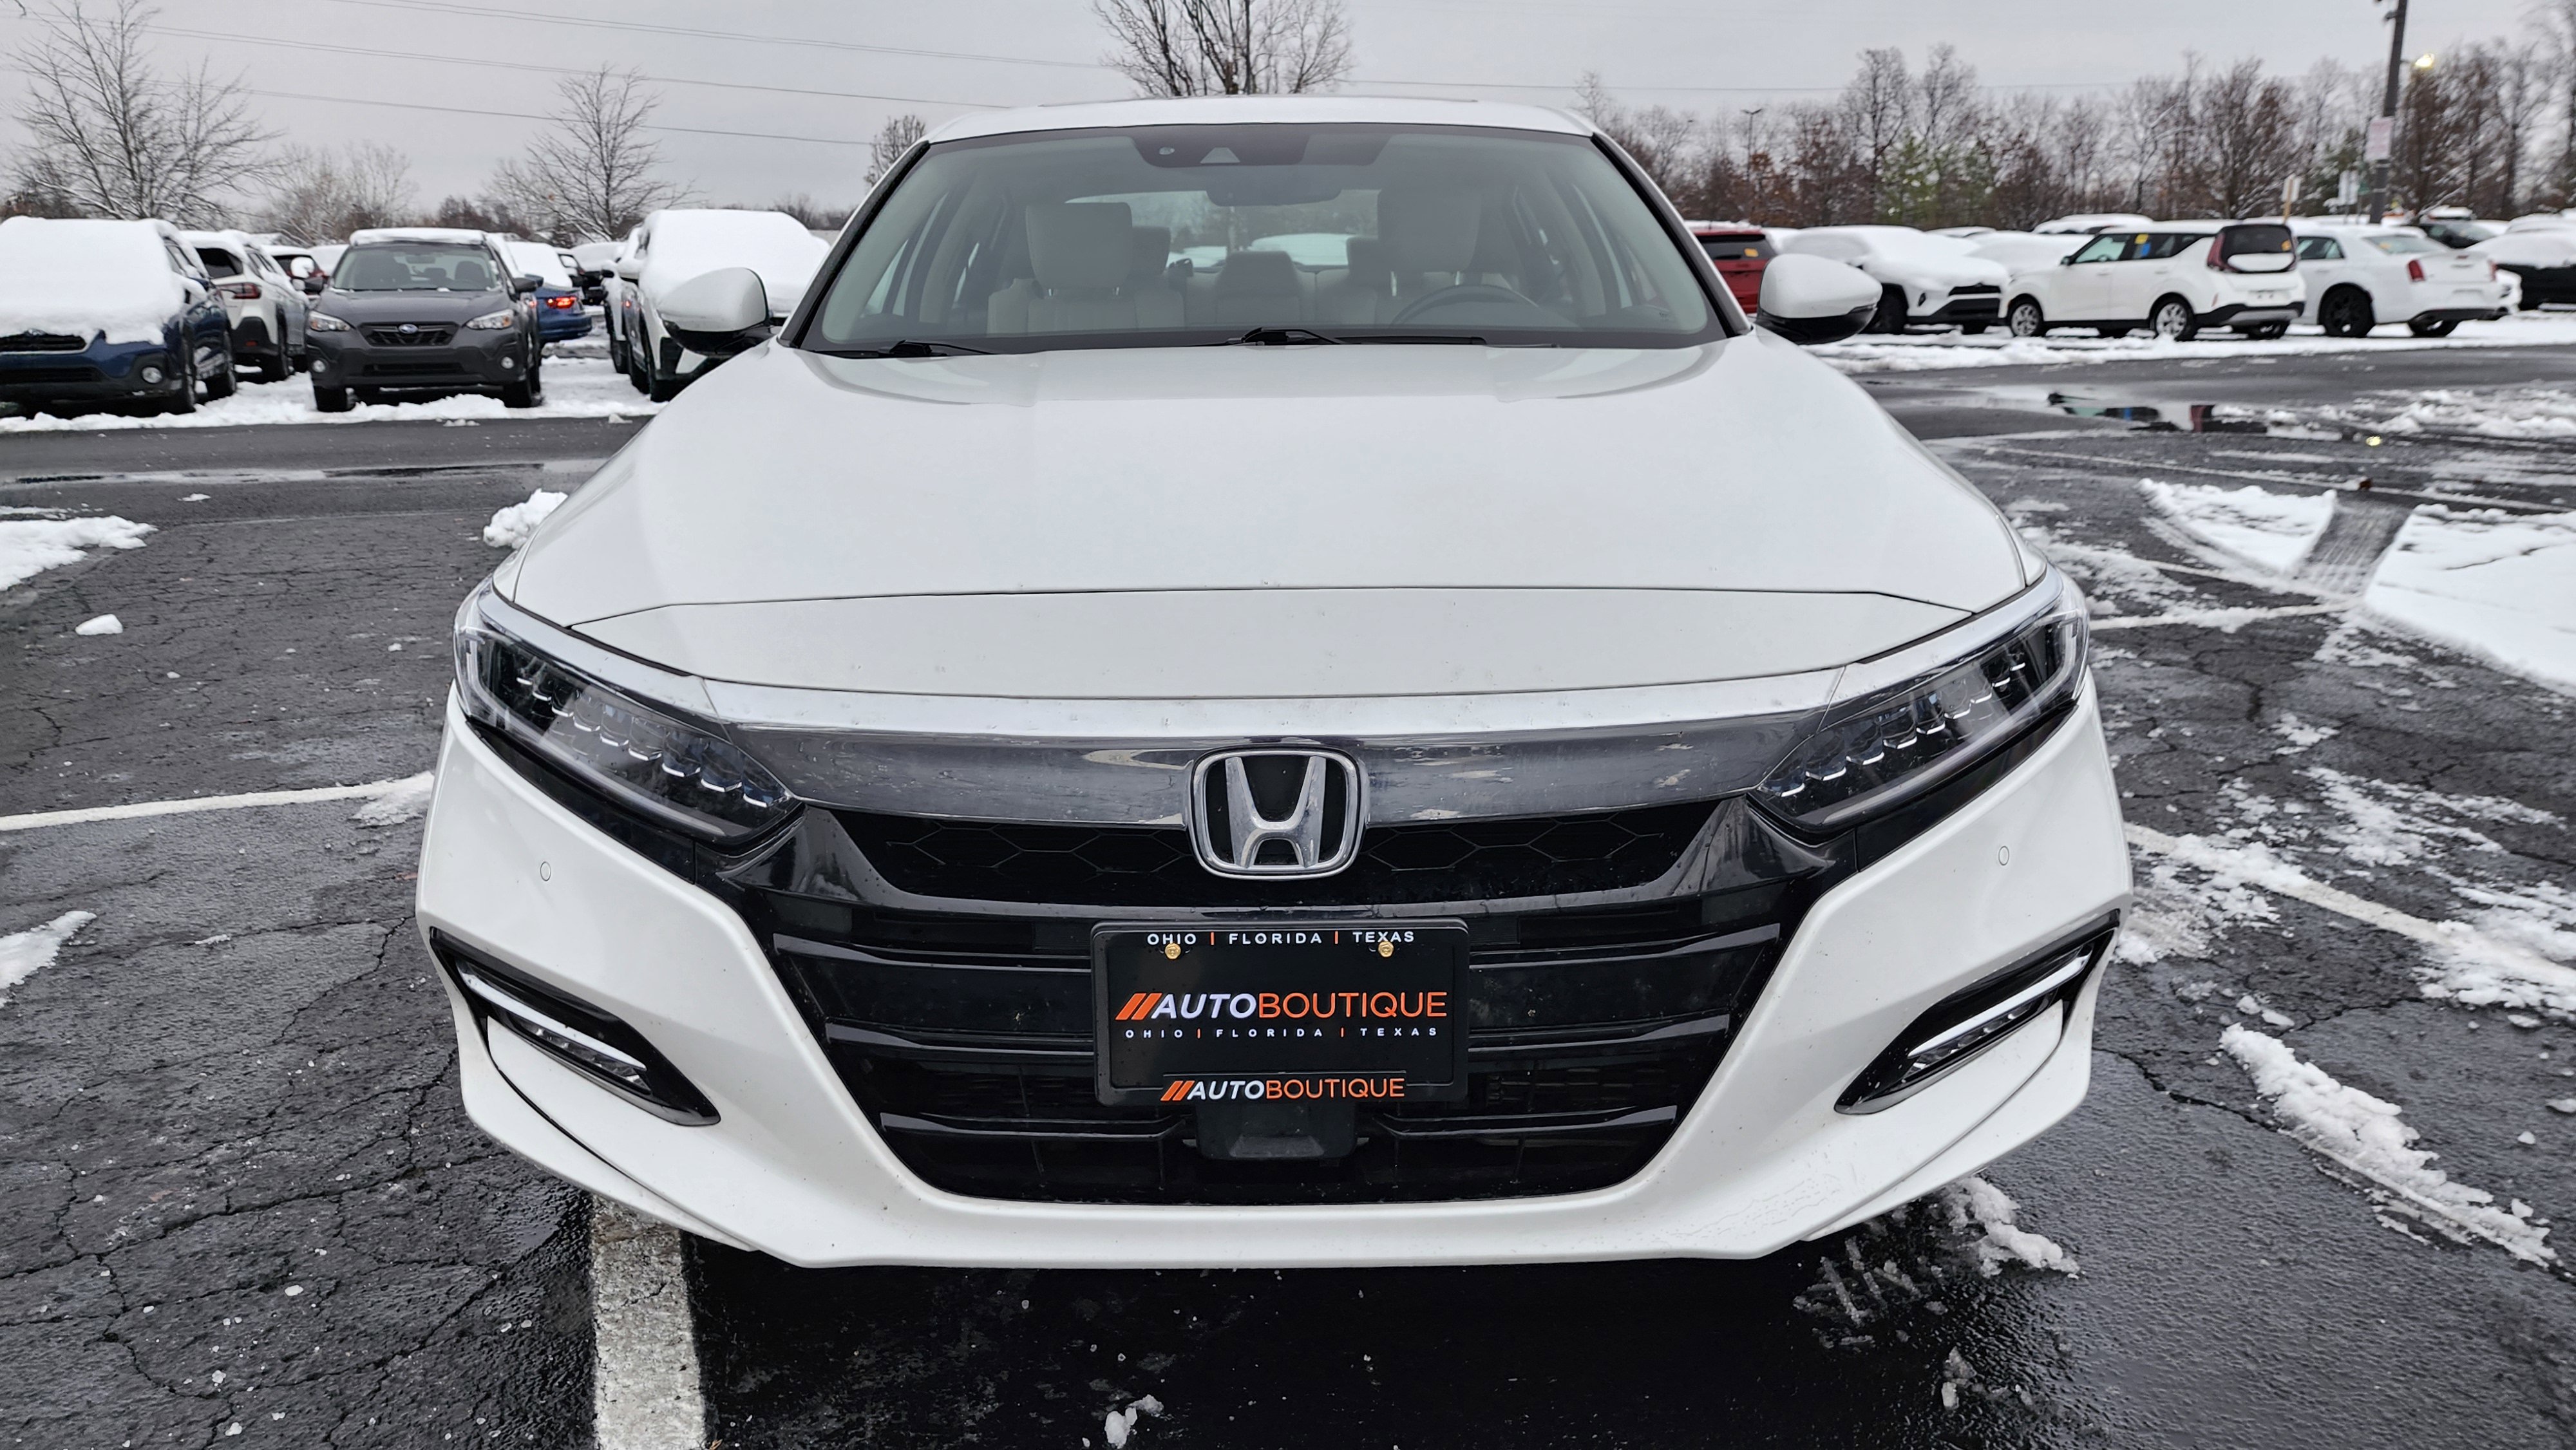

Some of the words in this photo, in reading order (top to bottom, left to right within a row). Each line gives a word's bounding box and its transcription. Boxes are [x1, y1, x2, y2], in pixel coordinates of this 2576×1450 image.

[1147, 933, 1197, 945] OHIO
[1229, 932, 1322, 945] FLORIDA
[1352, 931, 1415, 943] TEXAS
[1151, 992, 1447, 1019] AUTOBOUTIQUE
[1125, 1030, 1184, 1039] OHIO
[1216, 1029, 1323, 1038] FLORIDA
[1360, 1028, 1437, 1037] TEXAS
[1187, 1078, 1405, 1100] AUTOBOUTIQUE
